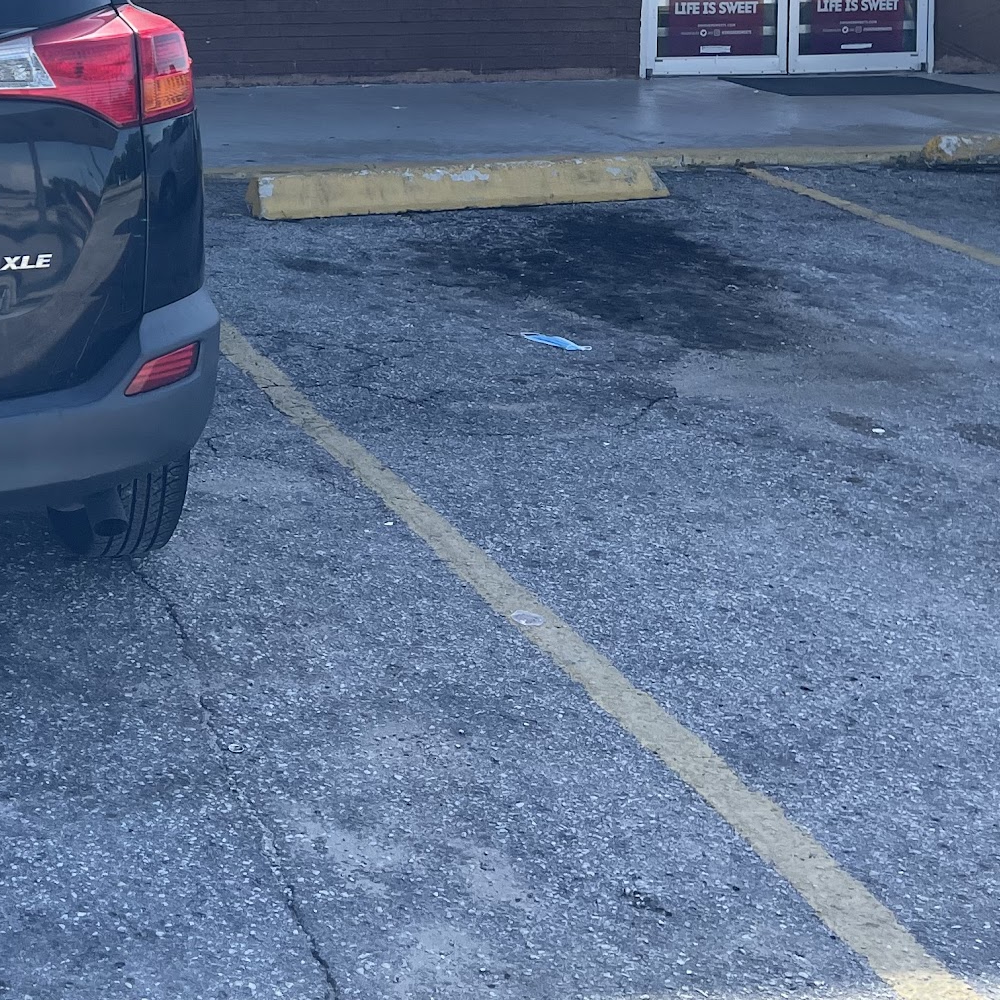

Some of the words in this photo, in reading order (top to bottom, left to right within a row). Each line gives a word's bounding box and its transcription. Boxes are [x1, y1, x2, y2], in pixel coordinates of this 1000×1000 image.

[674, 1, 700, 15] LIFE
[703, 1, 717, 14] IS
[719, 0, 759, 14] SWEET
[817, 0, 843, 13] LIFE
[0, 253, 53, 271] XLE
